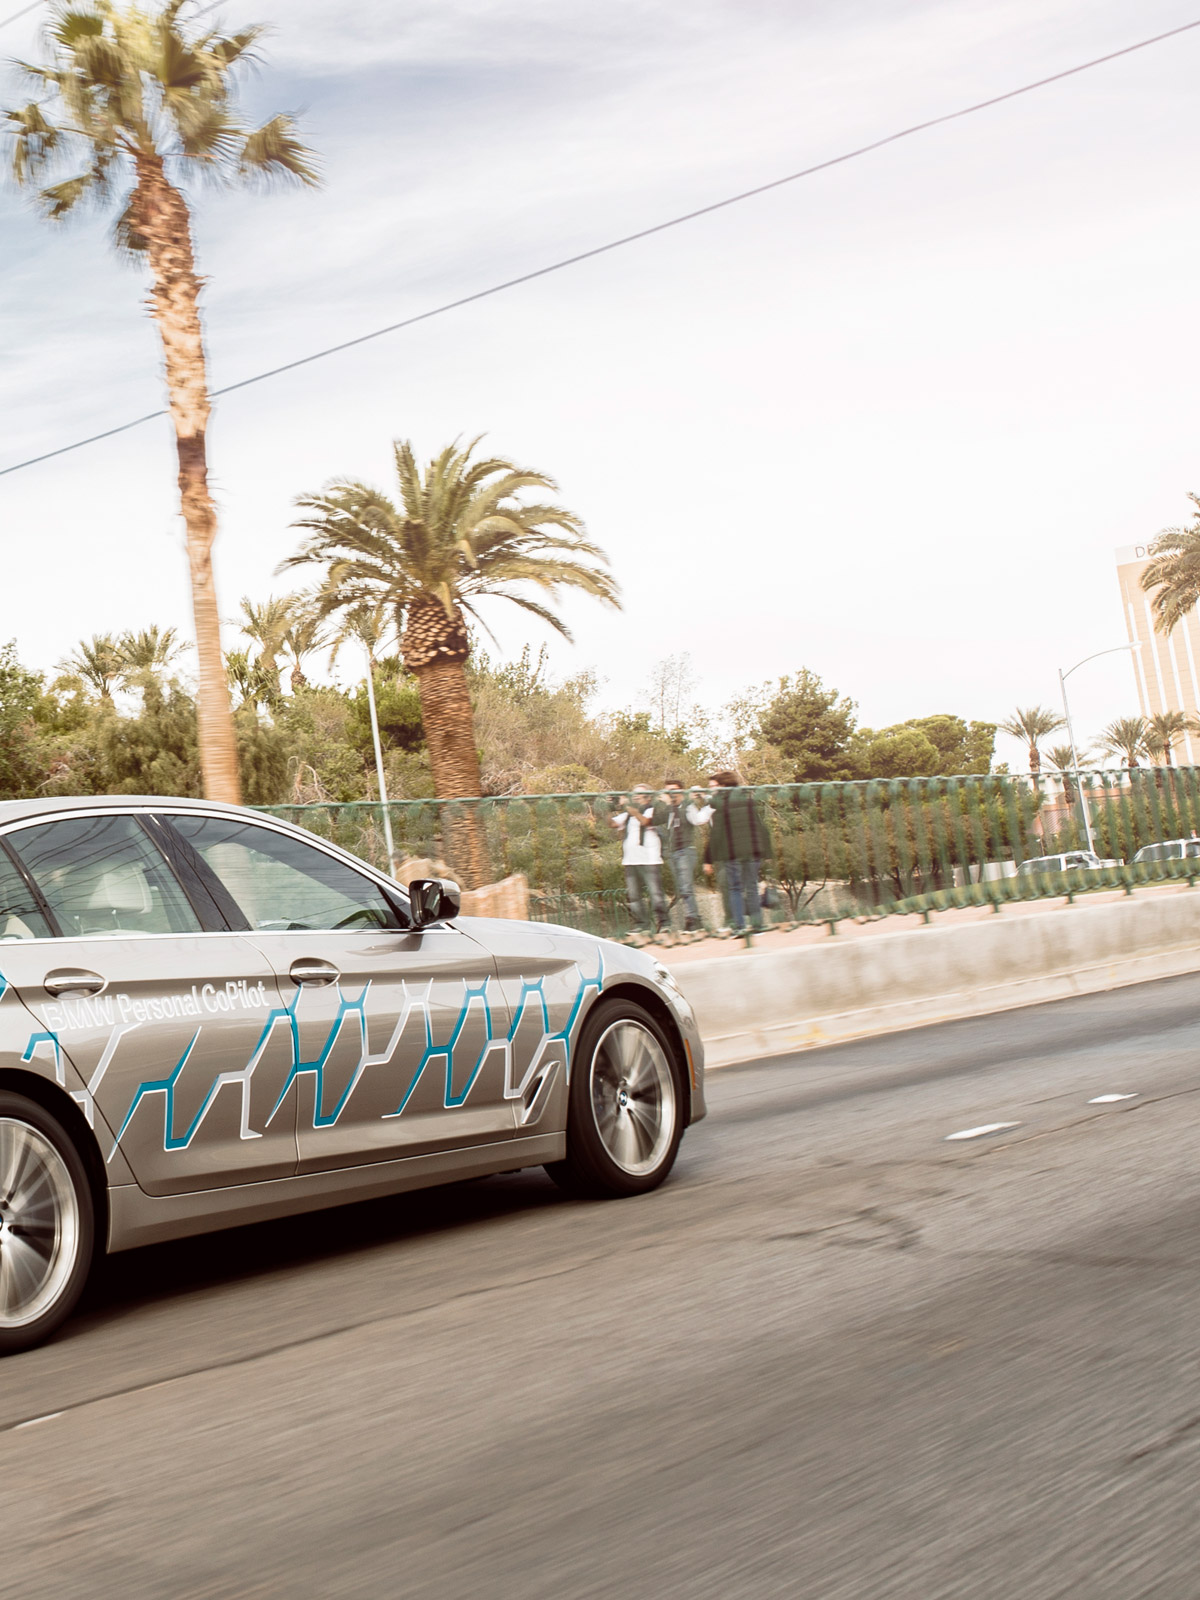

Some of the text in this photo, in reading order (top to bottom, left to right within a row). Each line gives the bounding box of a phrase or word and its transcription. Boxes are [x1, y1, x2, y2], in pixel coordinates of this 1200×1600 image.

[41, 980, 270, 1032] BMW Personal CoPilot
